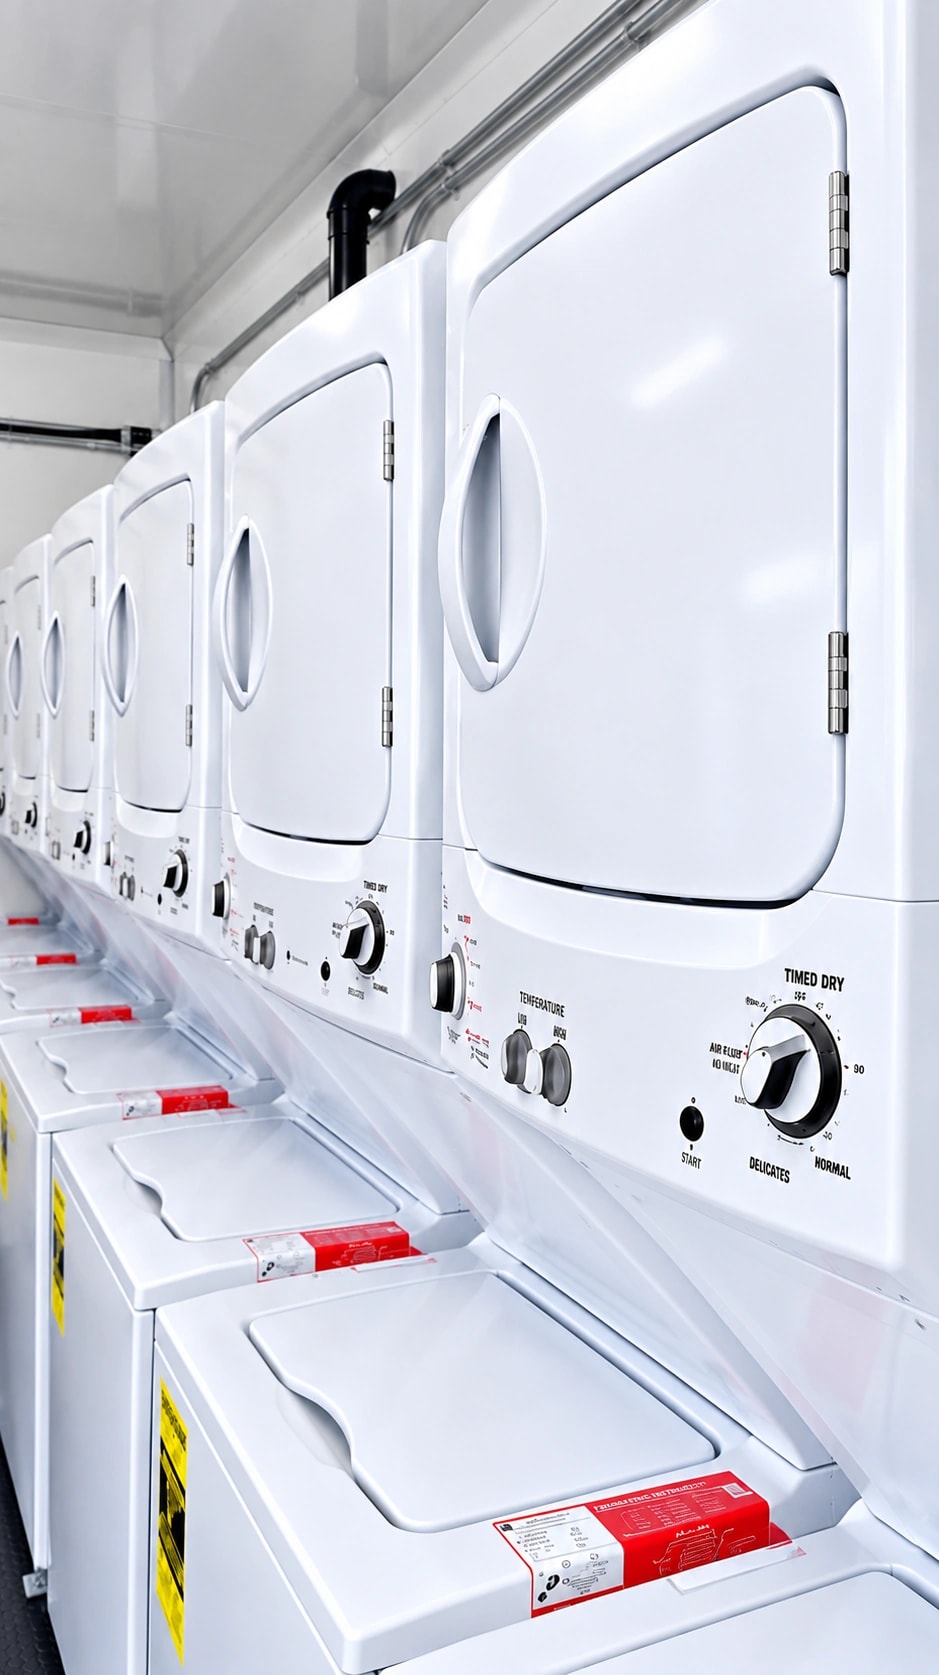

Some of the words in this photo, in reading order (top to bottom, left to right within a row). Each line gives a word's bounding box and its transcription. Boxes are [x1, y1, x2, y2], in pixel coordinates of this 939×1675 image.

[784, 968, 818, 987] TIMED
[820, 974, 845, 993] DRY
[853, 1064, 865, 1075] 90
[681, 1151, 702, 1170] START
[749, 1156, 791, 1184] DELICATES
